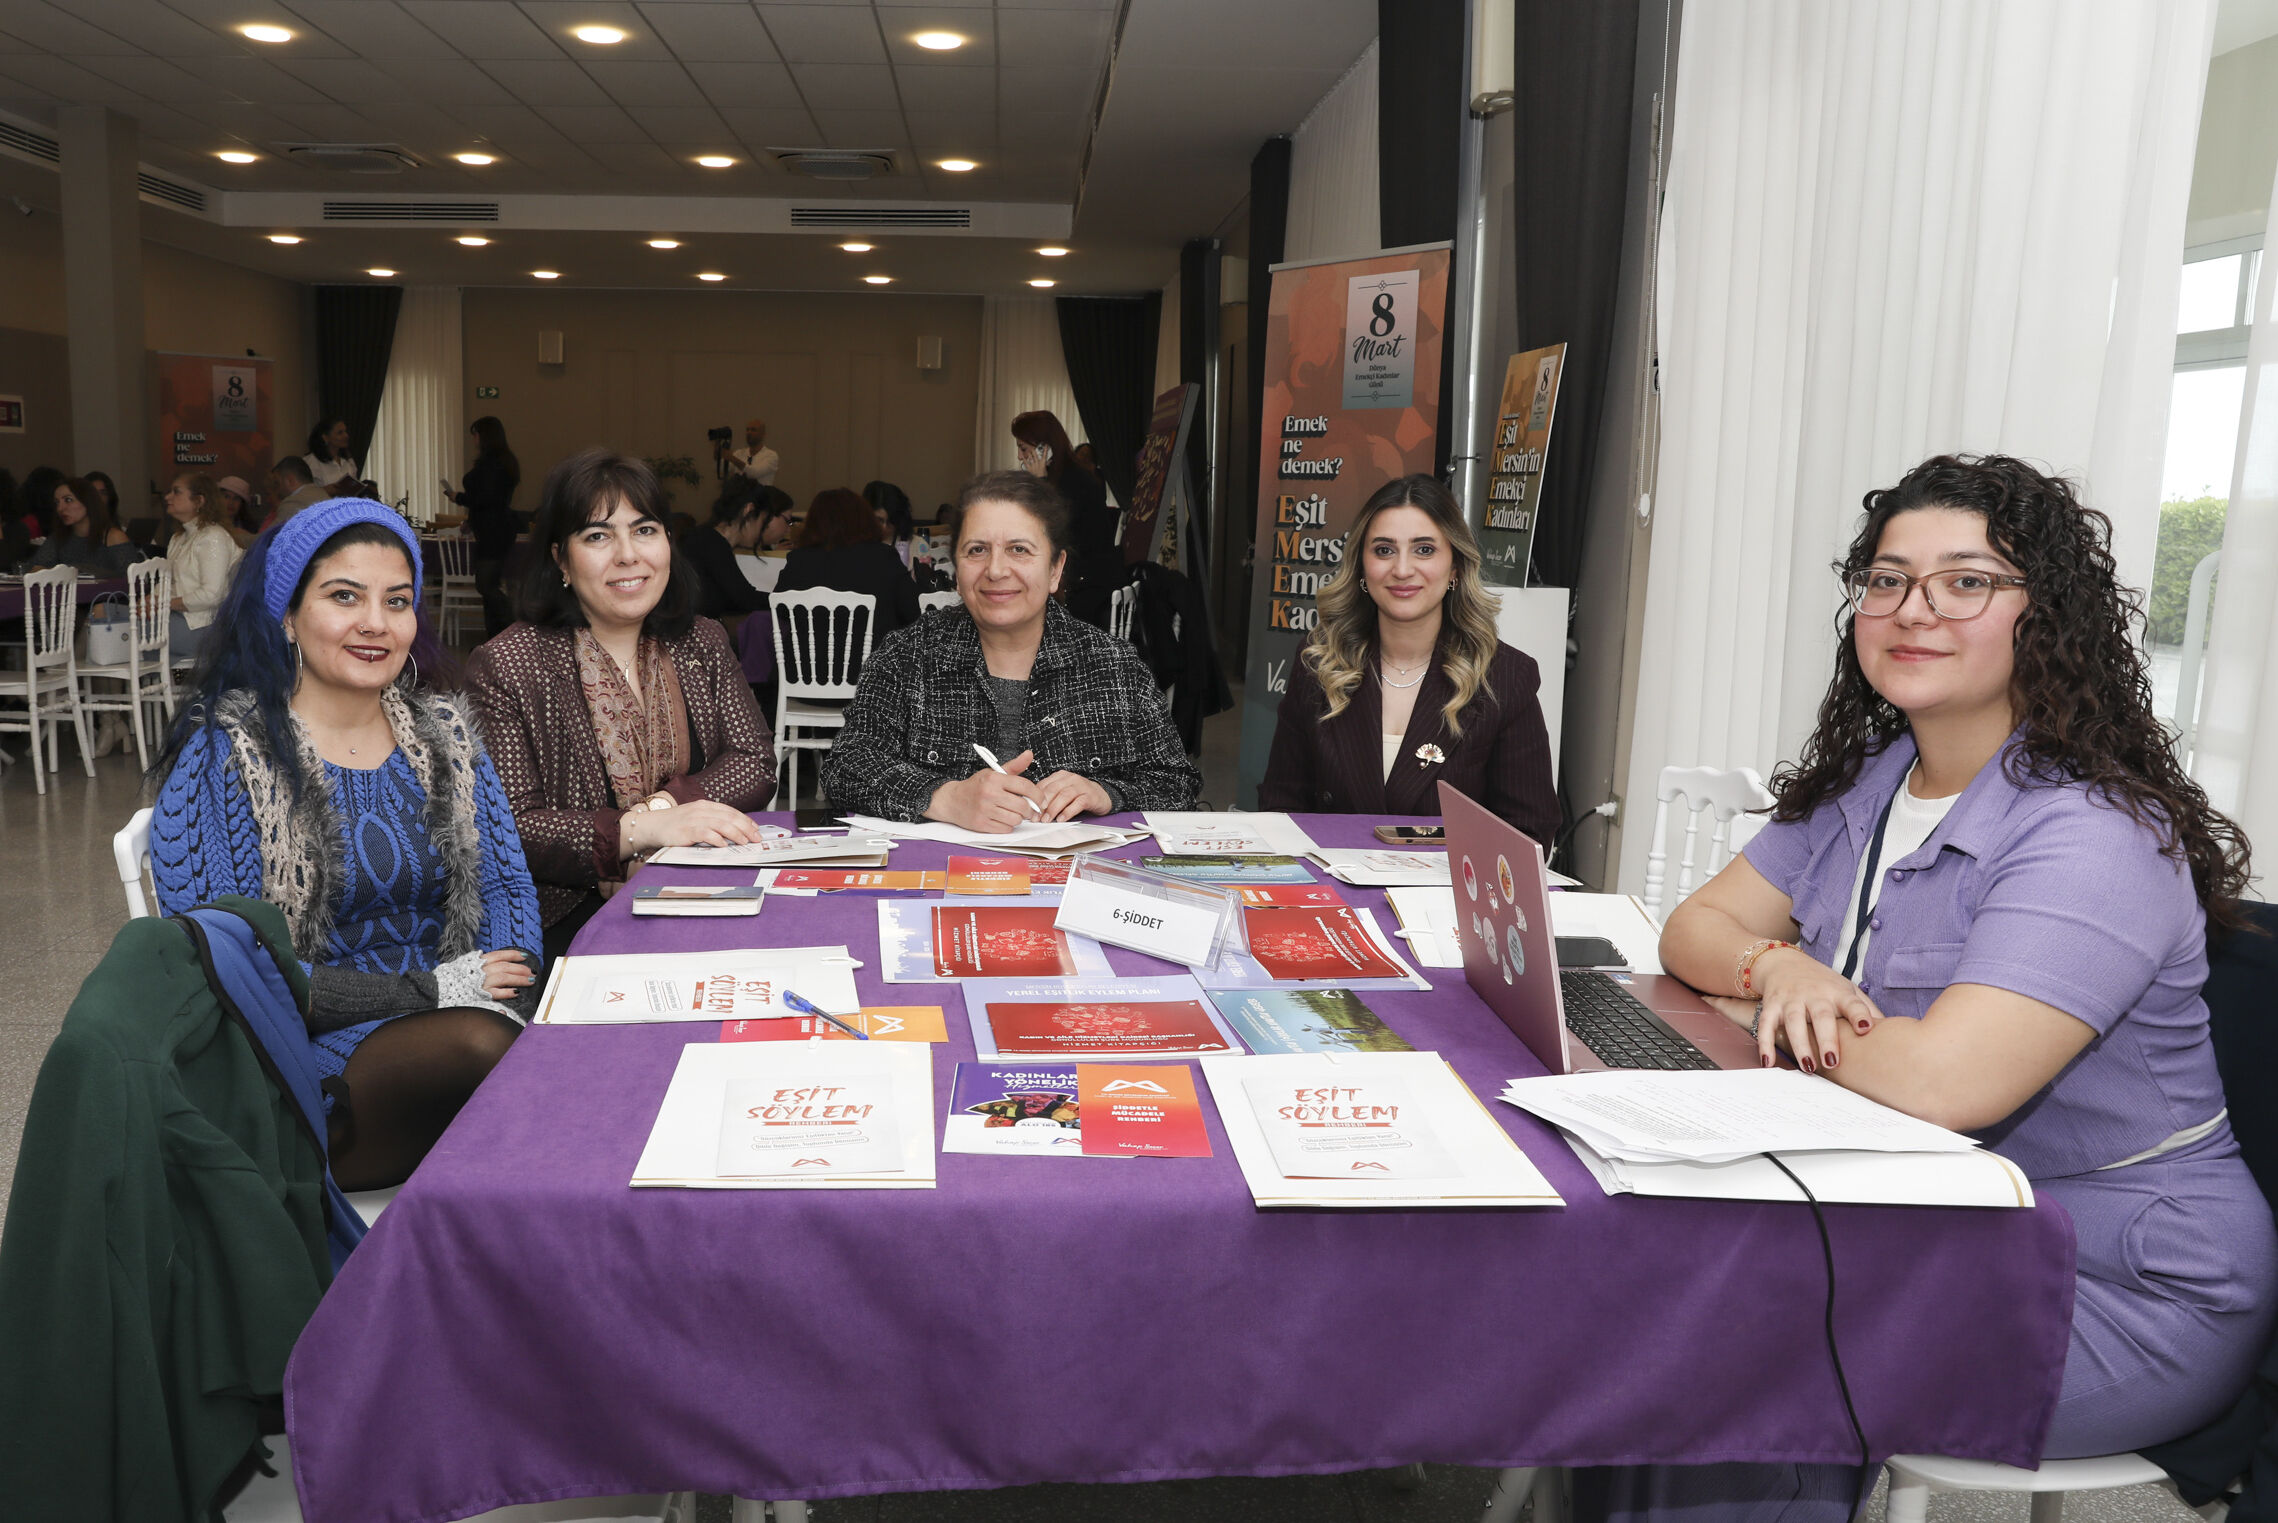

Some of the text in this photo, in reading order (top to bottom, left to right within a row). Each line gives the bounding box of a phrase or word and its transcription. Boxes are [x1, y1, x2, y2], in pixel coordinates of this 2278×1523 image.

[1369, 292, 1396, 337] 8
[1352, 334, 1407, 364] Mart
[227, 376, 244, 397] 8
[1540, 367, 1550, 392] 8
[1284, 415, 1328, 432] Emek
[1498, 420, 1518, 449] Eşit
[176, 443, 192, 452] ne
[1283, 439, 1303, 453] ne
[1281, 457, 1343, 475] demek?
[1494, 447, 1541, 473] Mersin'in
[1489, 475, 1527, 505] Emekçi
[1278, 493, 1328, 531] Eşit
[1485, 504, 1531, 530] Kadınları
[1273, 564, 1336, 595] Eme
[1112, 908, 1164, 930] 6-ŞİDDET
[702, 975, 740, 1013] SÖYLEM
[740, 981, 775, 1005] EŞİT
[773, 1085, 847, 1104] EŞİT
[1294, 1086, 1363, 1104] EŞİT
[746, 1104, 874, 1120] SÖYLEM
[1278, 1104, 1399, 1120] SÖYLEM
